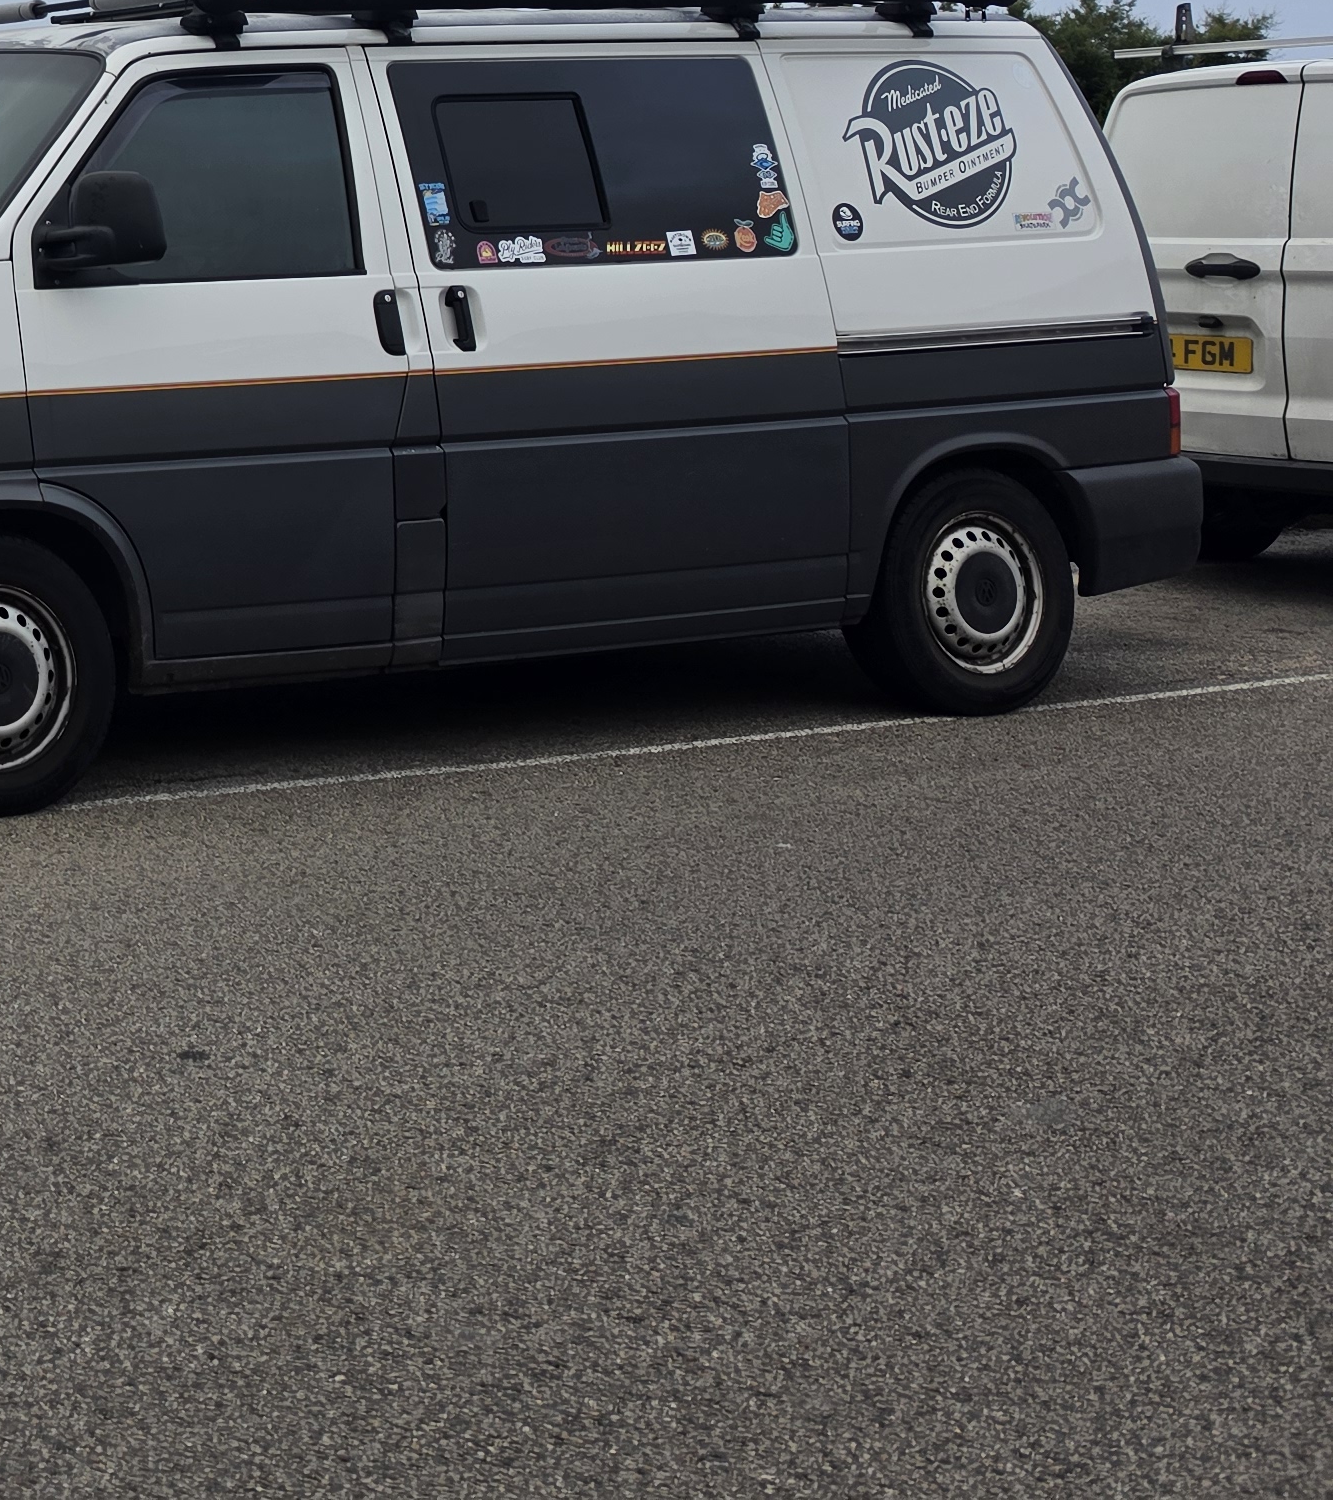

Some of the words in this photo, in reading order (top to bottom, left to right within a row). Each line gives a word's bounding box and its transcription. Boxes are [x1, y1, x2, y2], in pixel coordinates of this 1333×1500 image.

[880, 74, 942, 112] Medicated
[915, 168, 956, 195] BUMPER
[958, 143, 1006, 174] OINTMENT
[931, 200, 959, 217] REAR
[958, 203, 979, 217] END
[975, 170, 1003, 209] FORMULA
[1183, 339, 1235, 367] FGM
